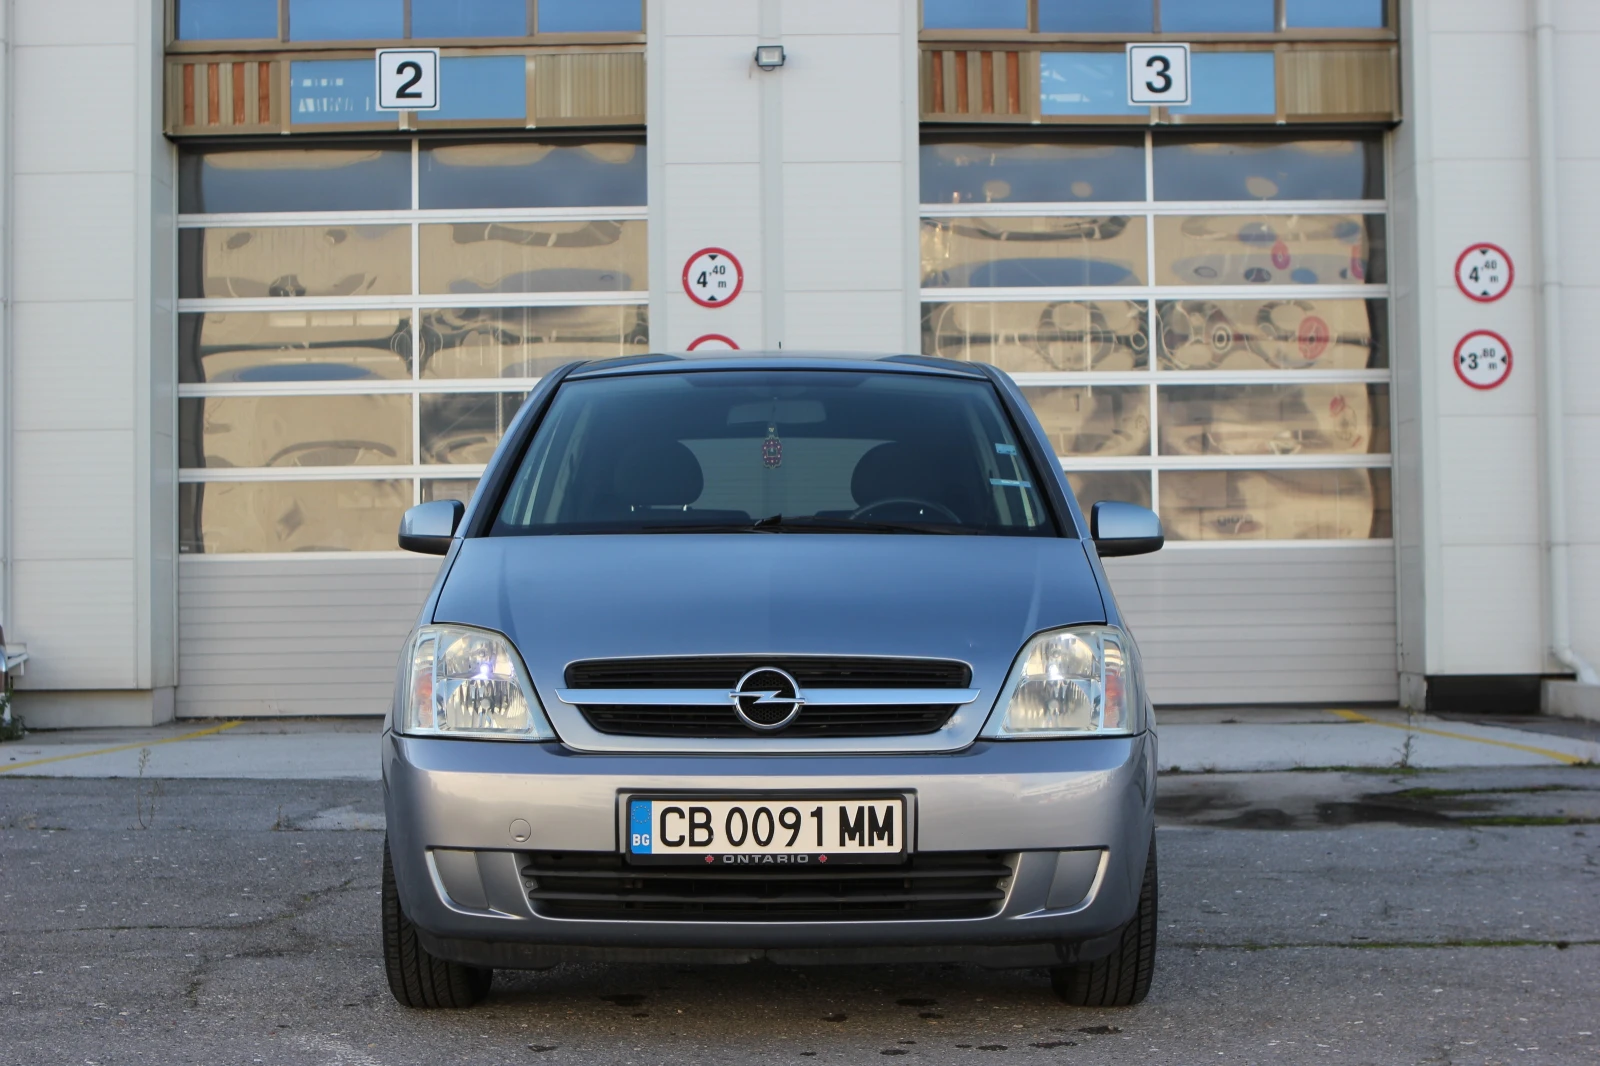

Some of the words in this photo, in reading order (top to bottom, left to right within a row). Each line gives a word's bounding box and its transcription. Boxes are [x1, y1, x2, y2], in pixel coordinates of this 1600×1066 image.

[395, 61, 423, 99] 2
[1145, 55, 1172, 94] 3
[717, 280, 727, 288] m
[632, 833, 650, 847] BG
[659, 806, 714, 847] CB
[725, 806, 823, 847] 0091
[839, 805, 894, 847] MM
[722, 854, 809, 864] ONTARIO
